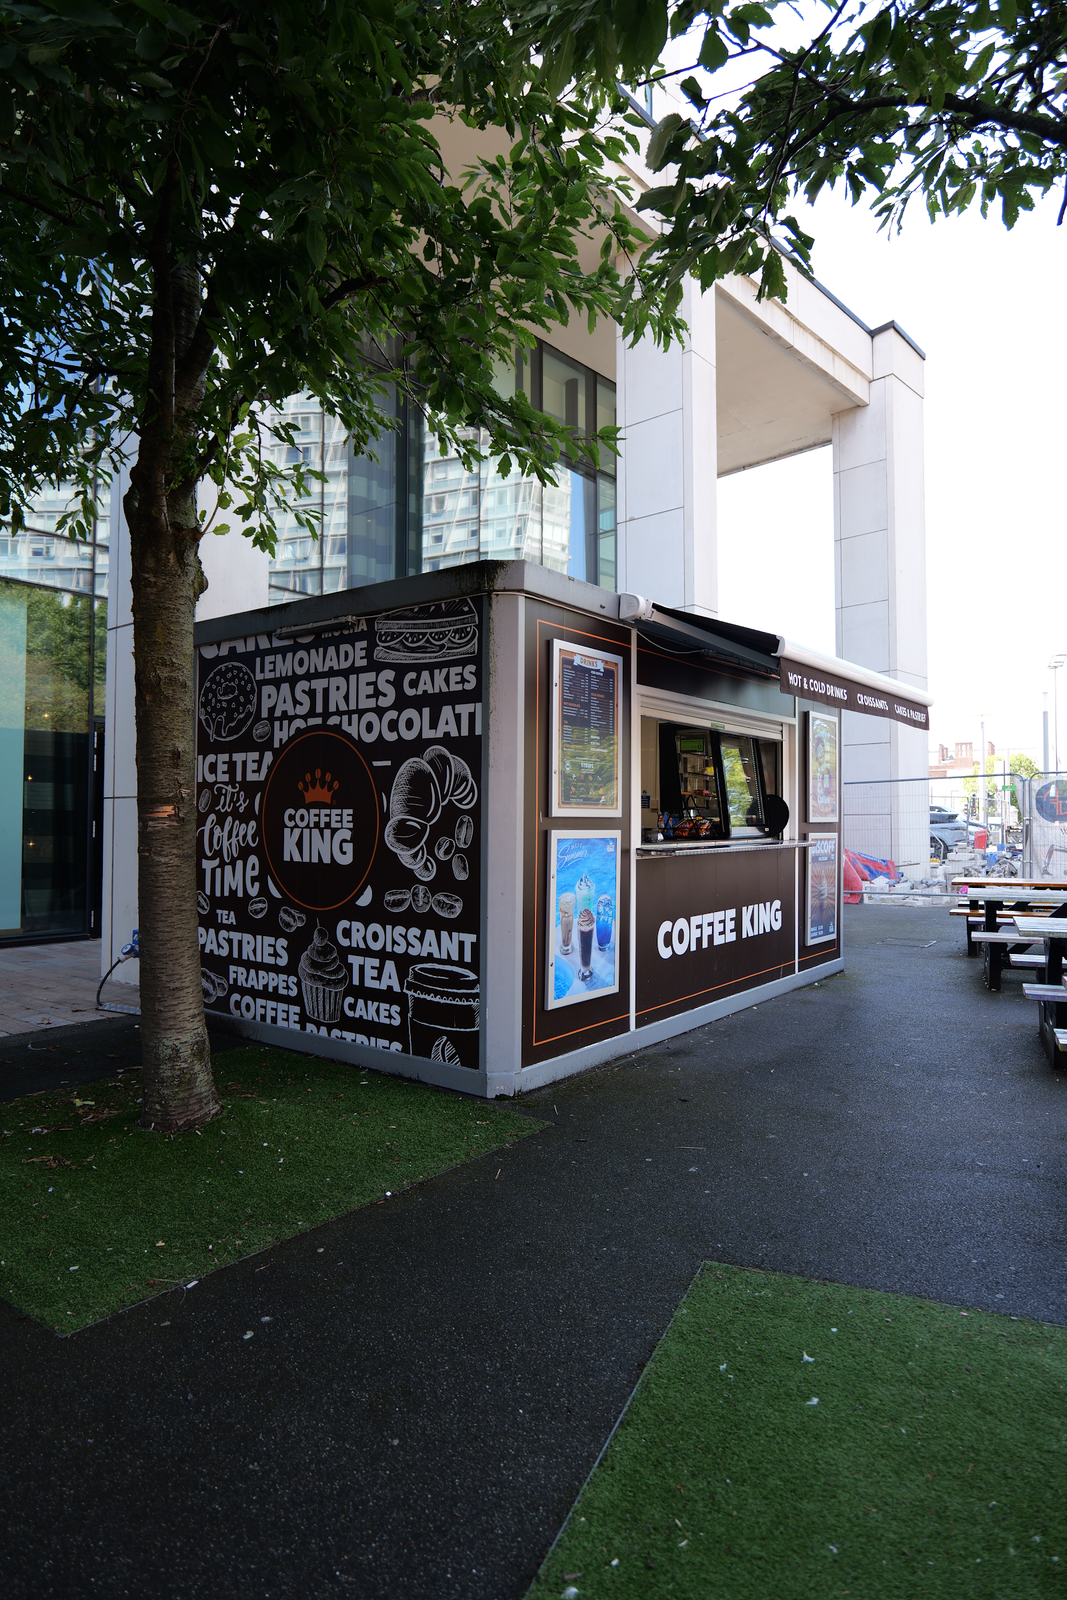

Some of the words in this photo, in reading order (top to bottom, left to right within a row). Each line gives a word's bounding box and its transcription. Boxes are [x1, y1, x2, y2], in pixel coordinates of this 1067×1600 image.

[255, 640, 368, 681] LEMONADE
[580, 657, 598, 668] DRINKS
[261, 669, 396, 718] PASTRIES
[403, 664, 477, 696] CAKES
[788, 672, 802, 687] HOT
[803, 678, 809, 690] &
[809, 679, 826, 694] COLD
[826, 684, 848, 701] DRINKS
[857, 693, 889, 711] CROISSANTS
[197, 753, 230, 783] ICE
[213, 783, 250, 813] it's
[283, 808, 354, 828] COFFEE
[197, 813, 259, 863] Coffee
[283, 828, 354, 866] KING
[216, 909, 236, 926] TEA
[657, 908, 737, 960] COFFEE
[741, 899, 782, 940] KING
[198, 926, 289, 967] PASTRIES
[336, 919, 477, 963] CROISSANT
[229, 965, 298, 997] FRAPPES
[347, 954, 402, 993] TEA
[229, 993, 301, 1031] COFFEE
[343, 996, 401, 1027] CAKES
